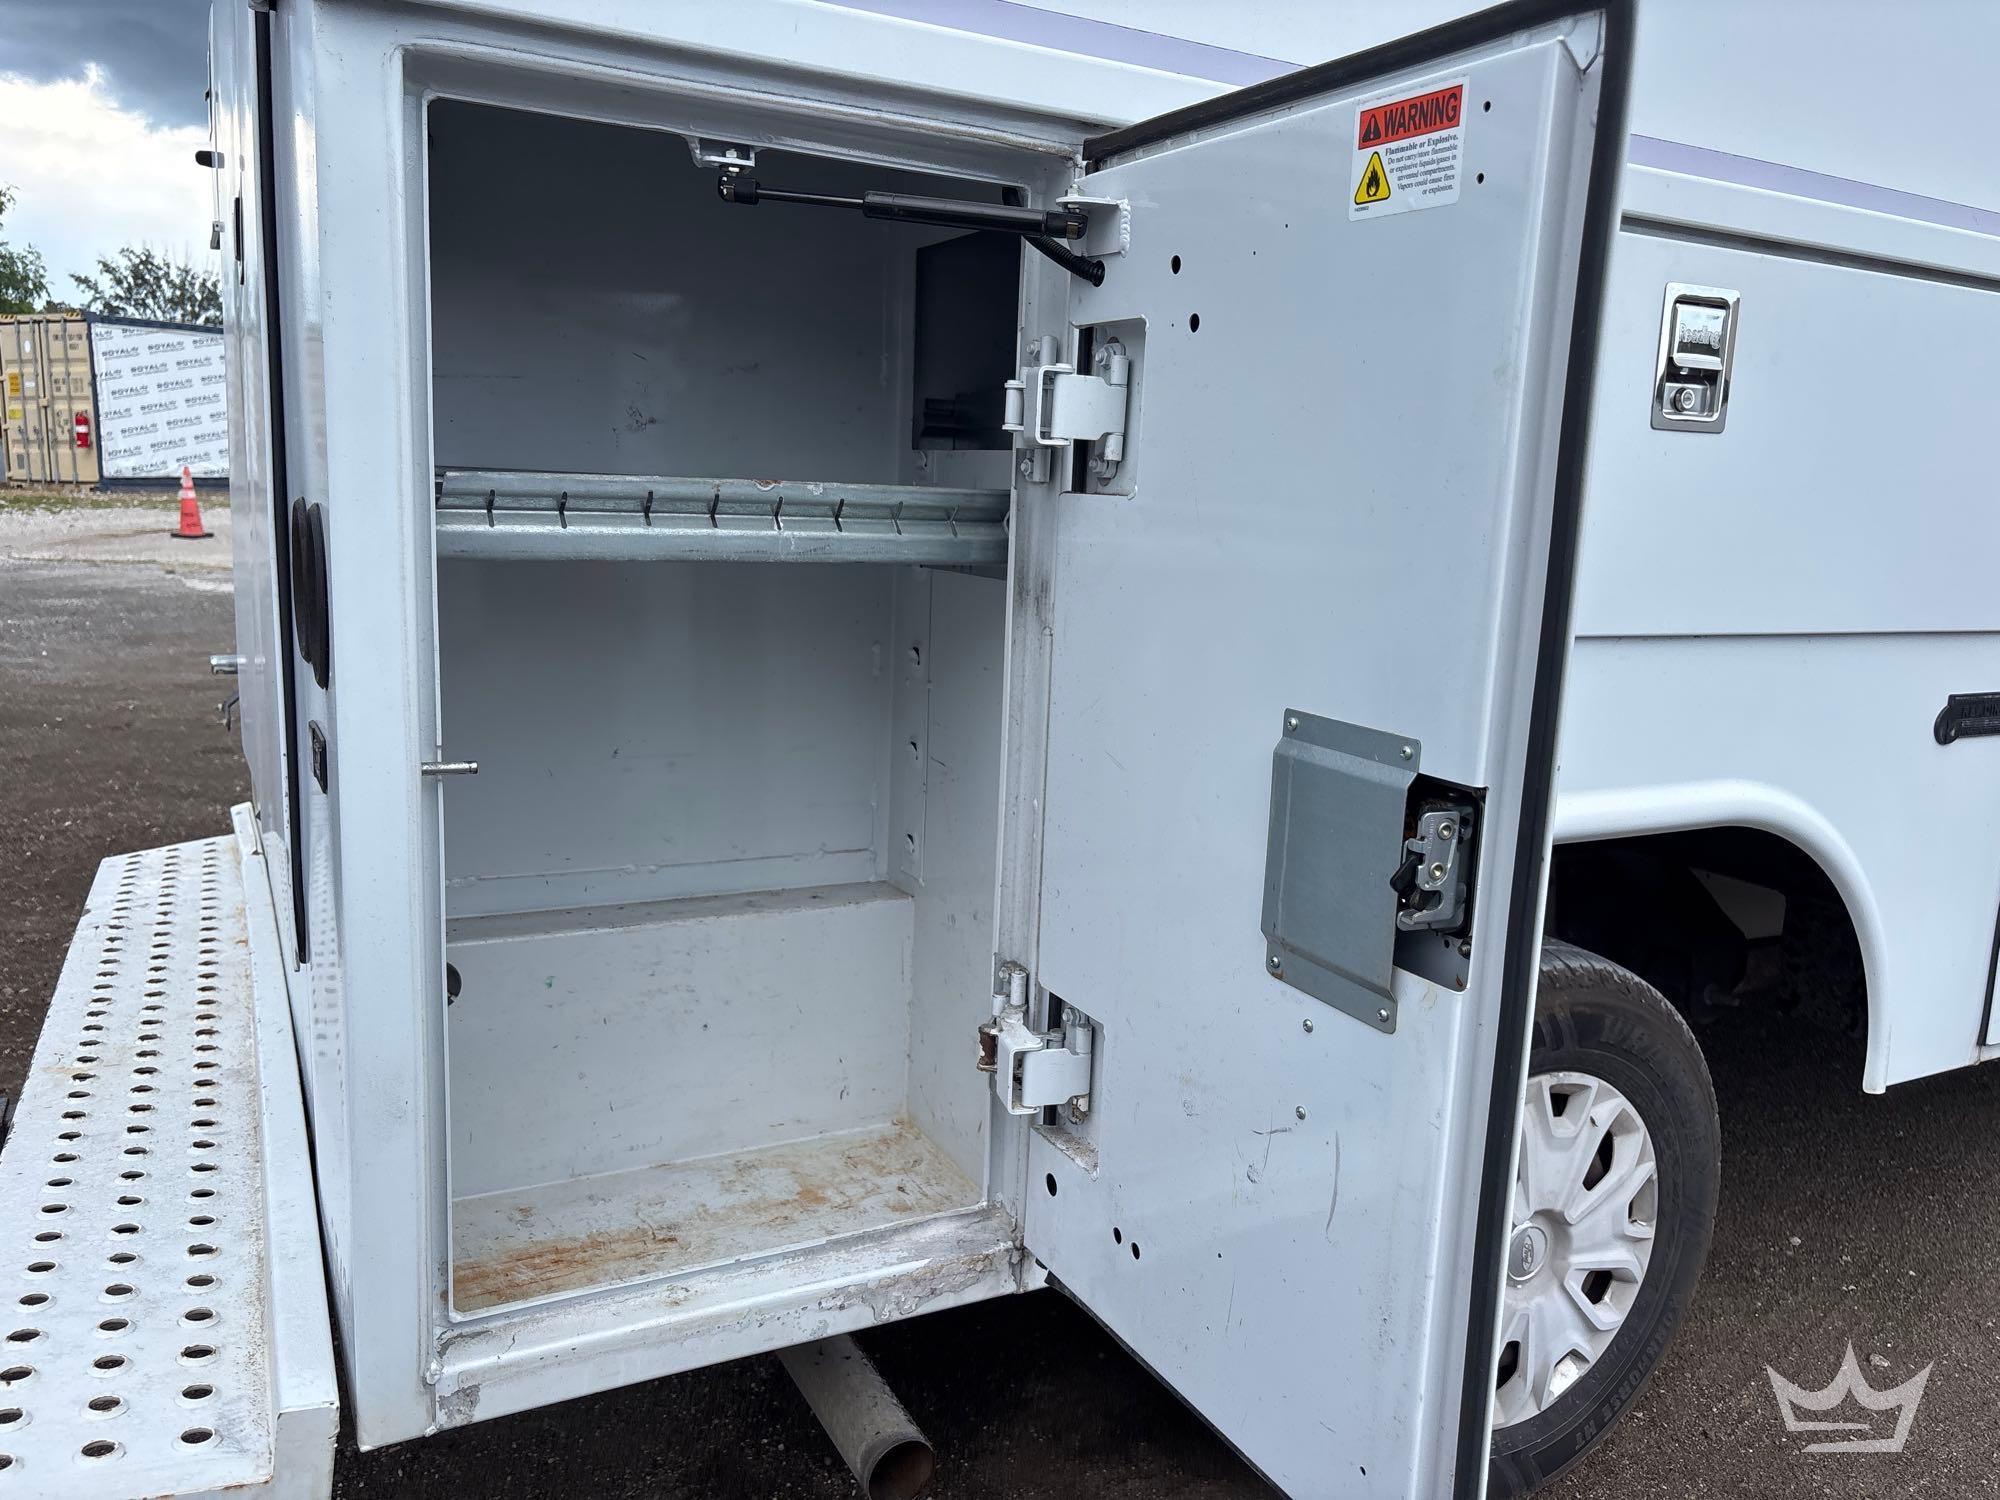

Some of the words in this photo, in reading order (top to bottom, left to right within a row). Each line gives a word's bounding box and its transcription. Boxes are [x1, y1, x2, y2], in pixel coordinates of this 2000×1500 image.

[1384, 92, 1458, 138] WARNING
[1385, 143, 1417, 156] Flammable
[1427, 134, 1458, 146] Explosive.
[1679, 322, 1721, 350] Reading
[1602, 1295, 1683, 1423] WORKHORSE
[1575, 1418, 1598, 1451] HT
